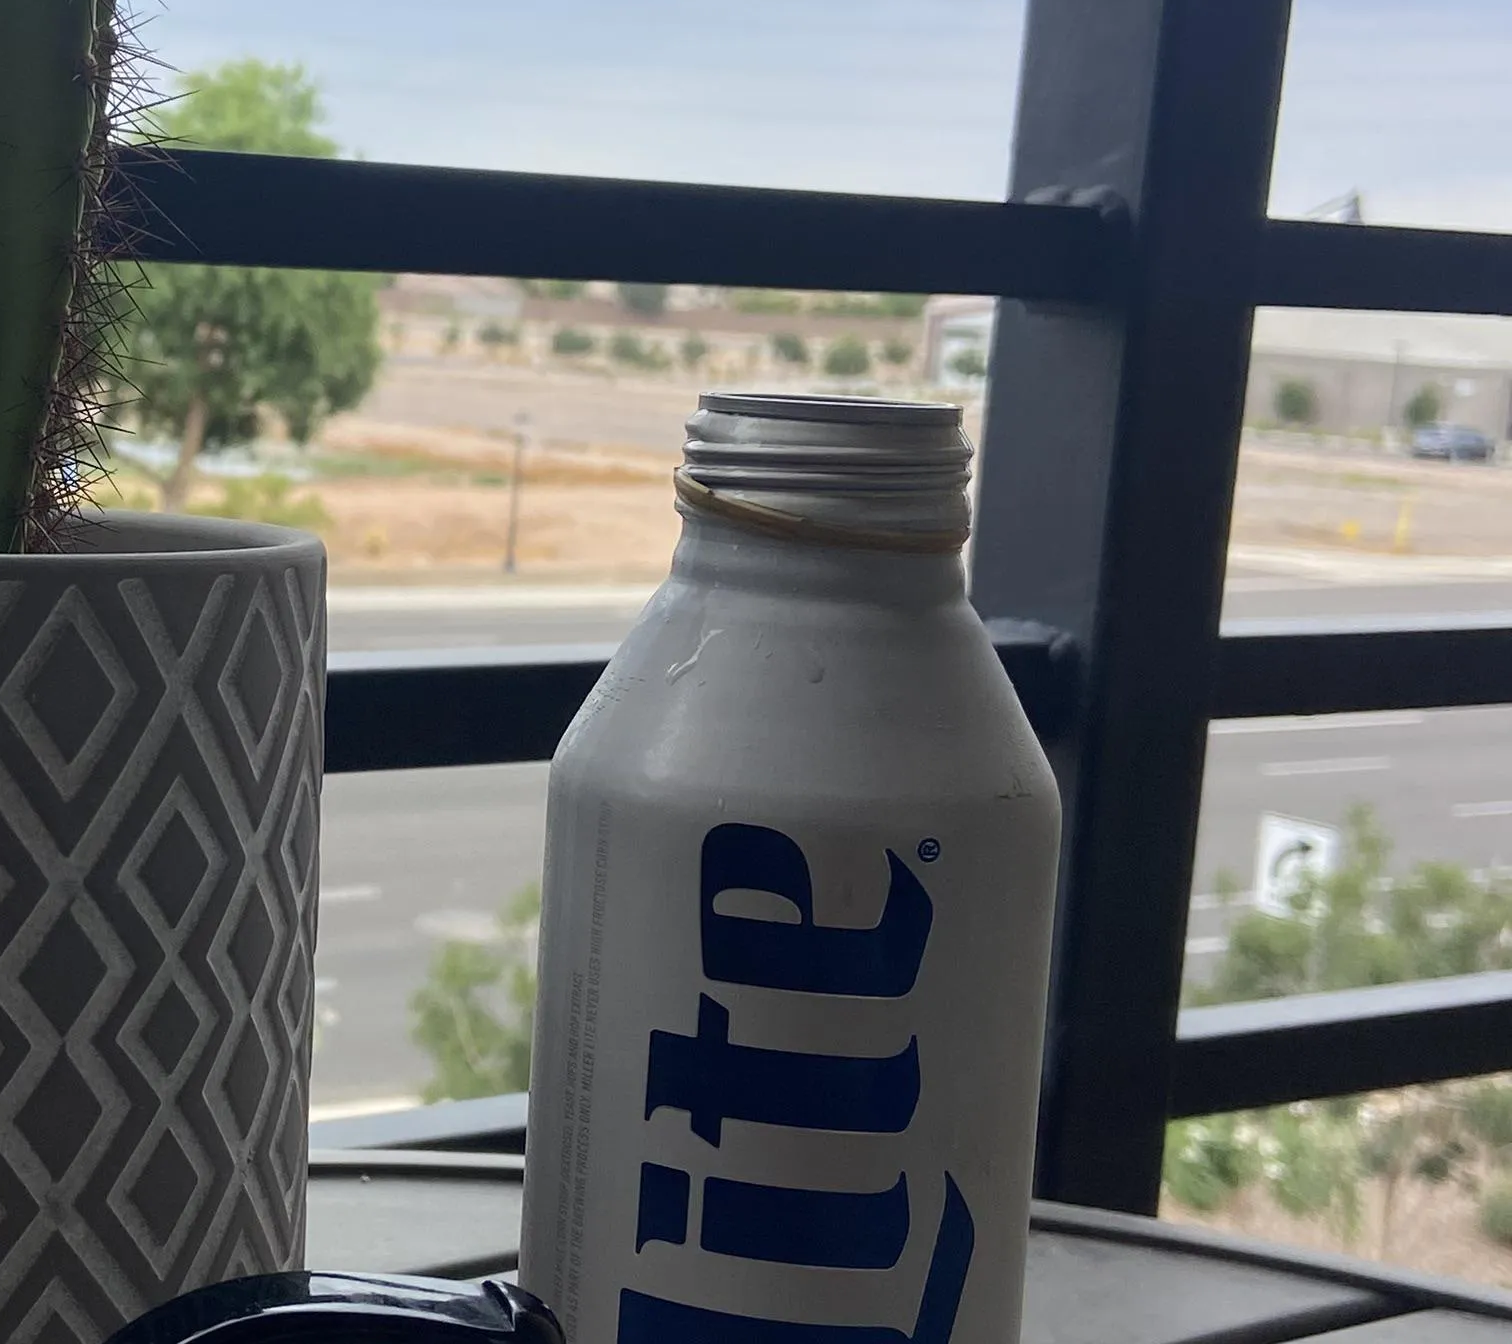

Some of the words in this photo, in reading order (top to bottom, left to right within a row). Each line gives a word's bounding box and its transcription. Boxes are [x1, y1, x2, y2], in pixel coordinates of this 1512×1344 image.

[594, 838, 609, 868] CORN
[591, 868, 607, 927] FRUCTOSE
[590, 927, 604, 956] HIGH
[587, 957, 601, 986] USES
[570, 973, 583, 1015] EXTRACT
[584, 988, 600, 1023] NEVER
[567, 1037, 579, 1060] AND
[582, 1023, 597, 1050] LITE
[581, 1052, 596, 1093] MILLER
[575, 1126, 590, 1176] PROCESS
[572, 1177, 587, 1228] BREWING
[571, 1229, 584, 1250] THE
[570, 1252, 583, 1267] OF
[568, 1268, 581, 1296] PART
[567, 1296, 579, 1311] AS
